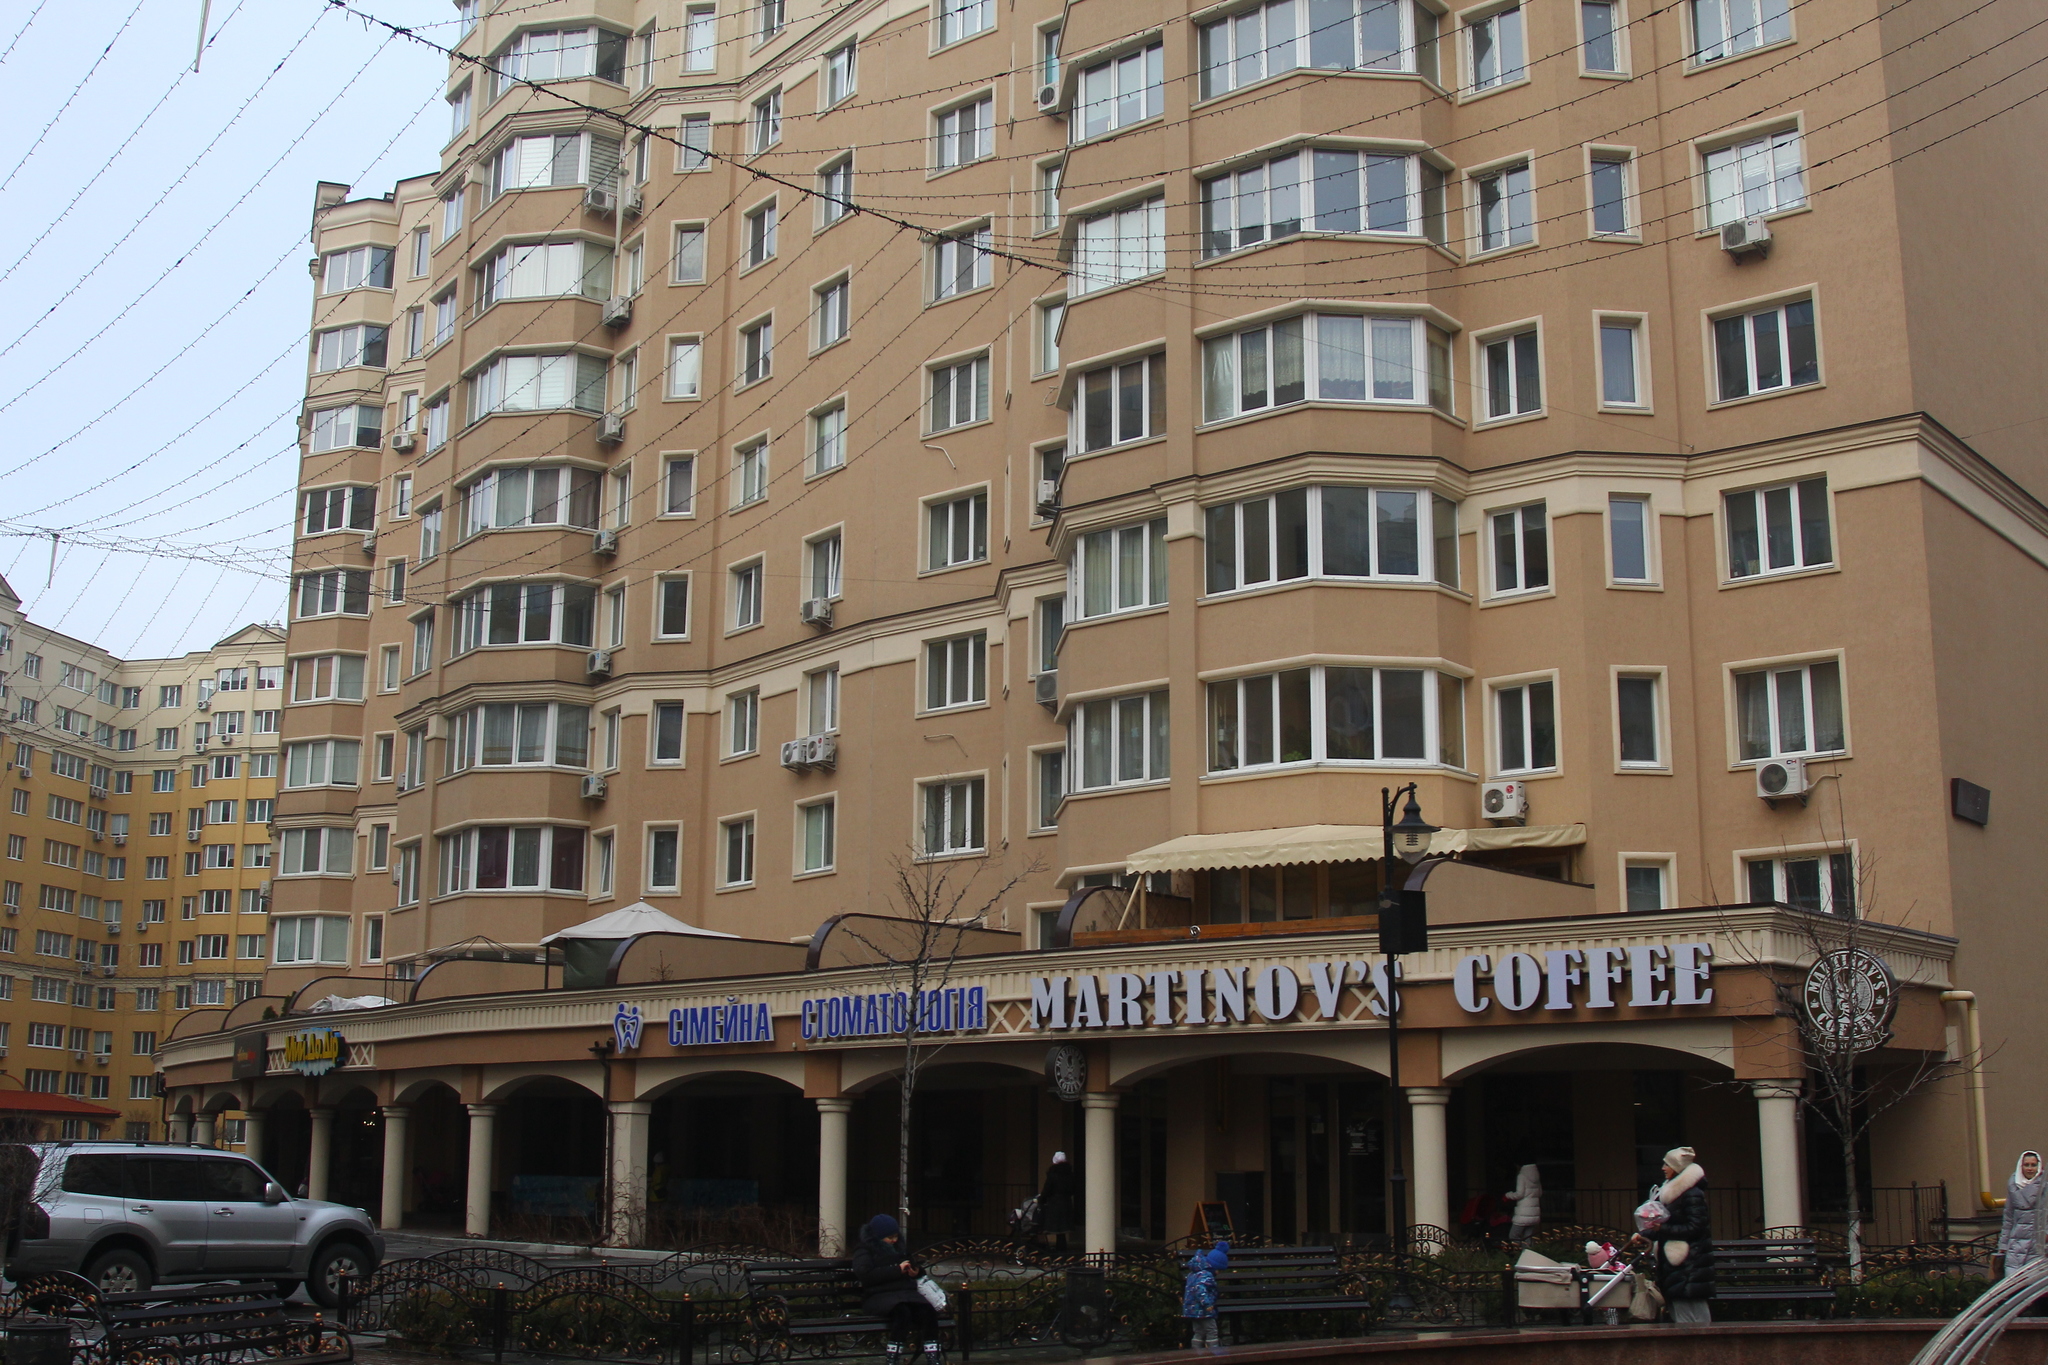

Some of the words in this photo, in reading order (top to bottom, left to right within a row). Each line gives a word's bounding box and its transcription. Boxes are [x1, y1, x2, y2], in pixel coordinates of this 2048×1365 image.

[667, 996, 774, 1046] СІМЕЙНА
[801, 986, 987, 1040] СТОМАТОЛОГІЯ
[1029, 960, 1402, 1029] MARTINOV'S
[1453, 942, 1713, 1013] COFFEE
